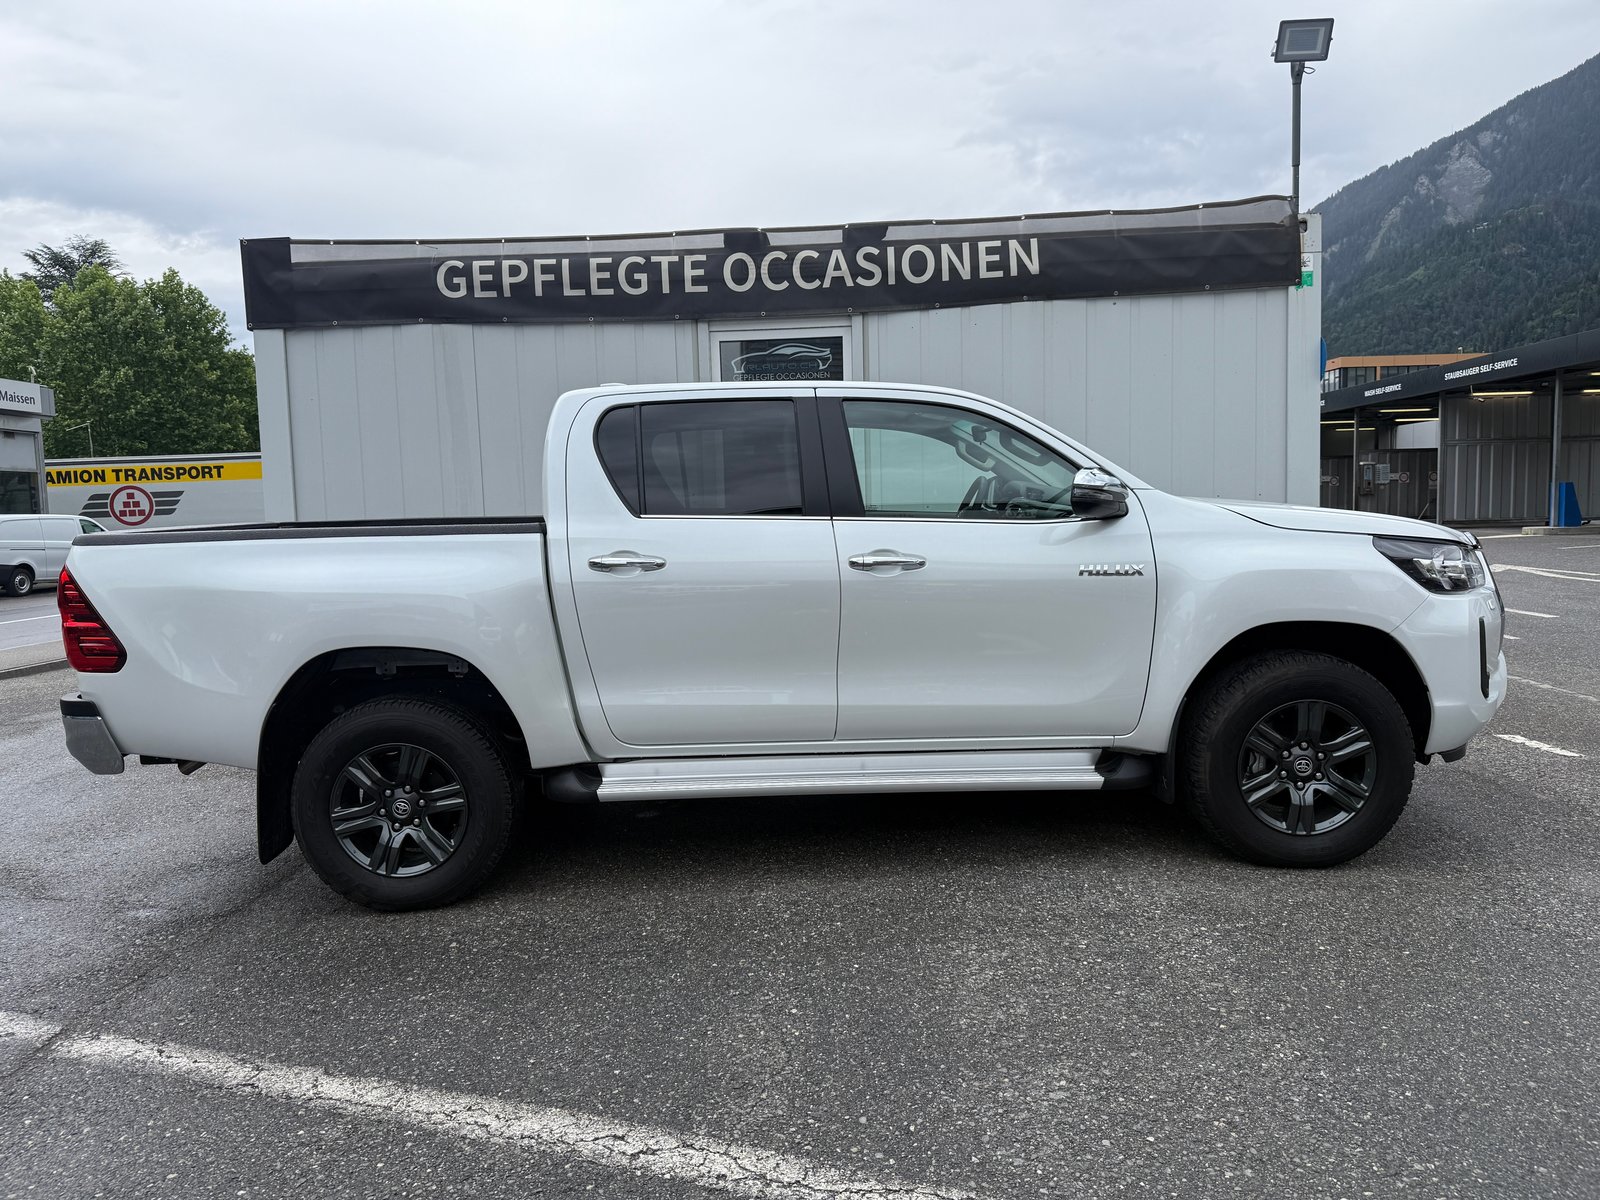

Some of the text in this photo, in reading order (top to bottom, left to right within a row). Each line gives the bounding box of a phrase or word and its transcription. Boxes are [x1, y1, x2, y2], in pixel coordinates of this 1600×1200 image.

[436, 237, 1041, 299] GEPFLEGTE OCCASIONEN
[733, 371, 831, 381] GEPFLEGTE OCCASIONEN
[1444, 357, 1518, 381] STAUBSAUGER SELF-SERVICE
[0, 389, 36, 405] Maissen
[46, 465, 225, 485] AMION TRANSPORT
[1078, 563, 1145, 576] HILUX
